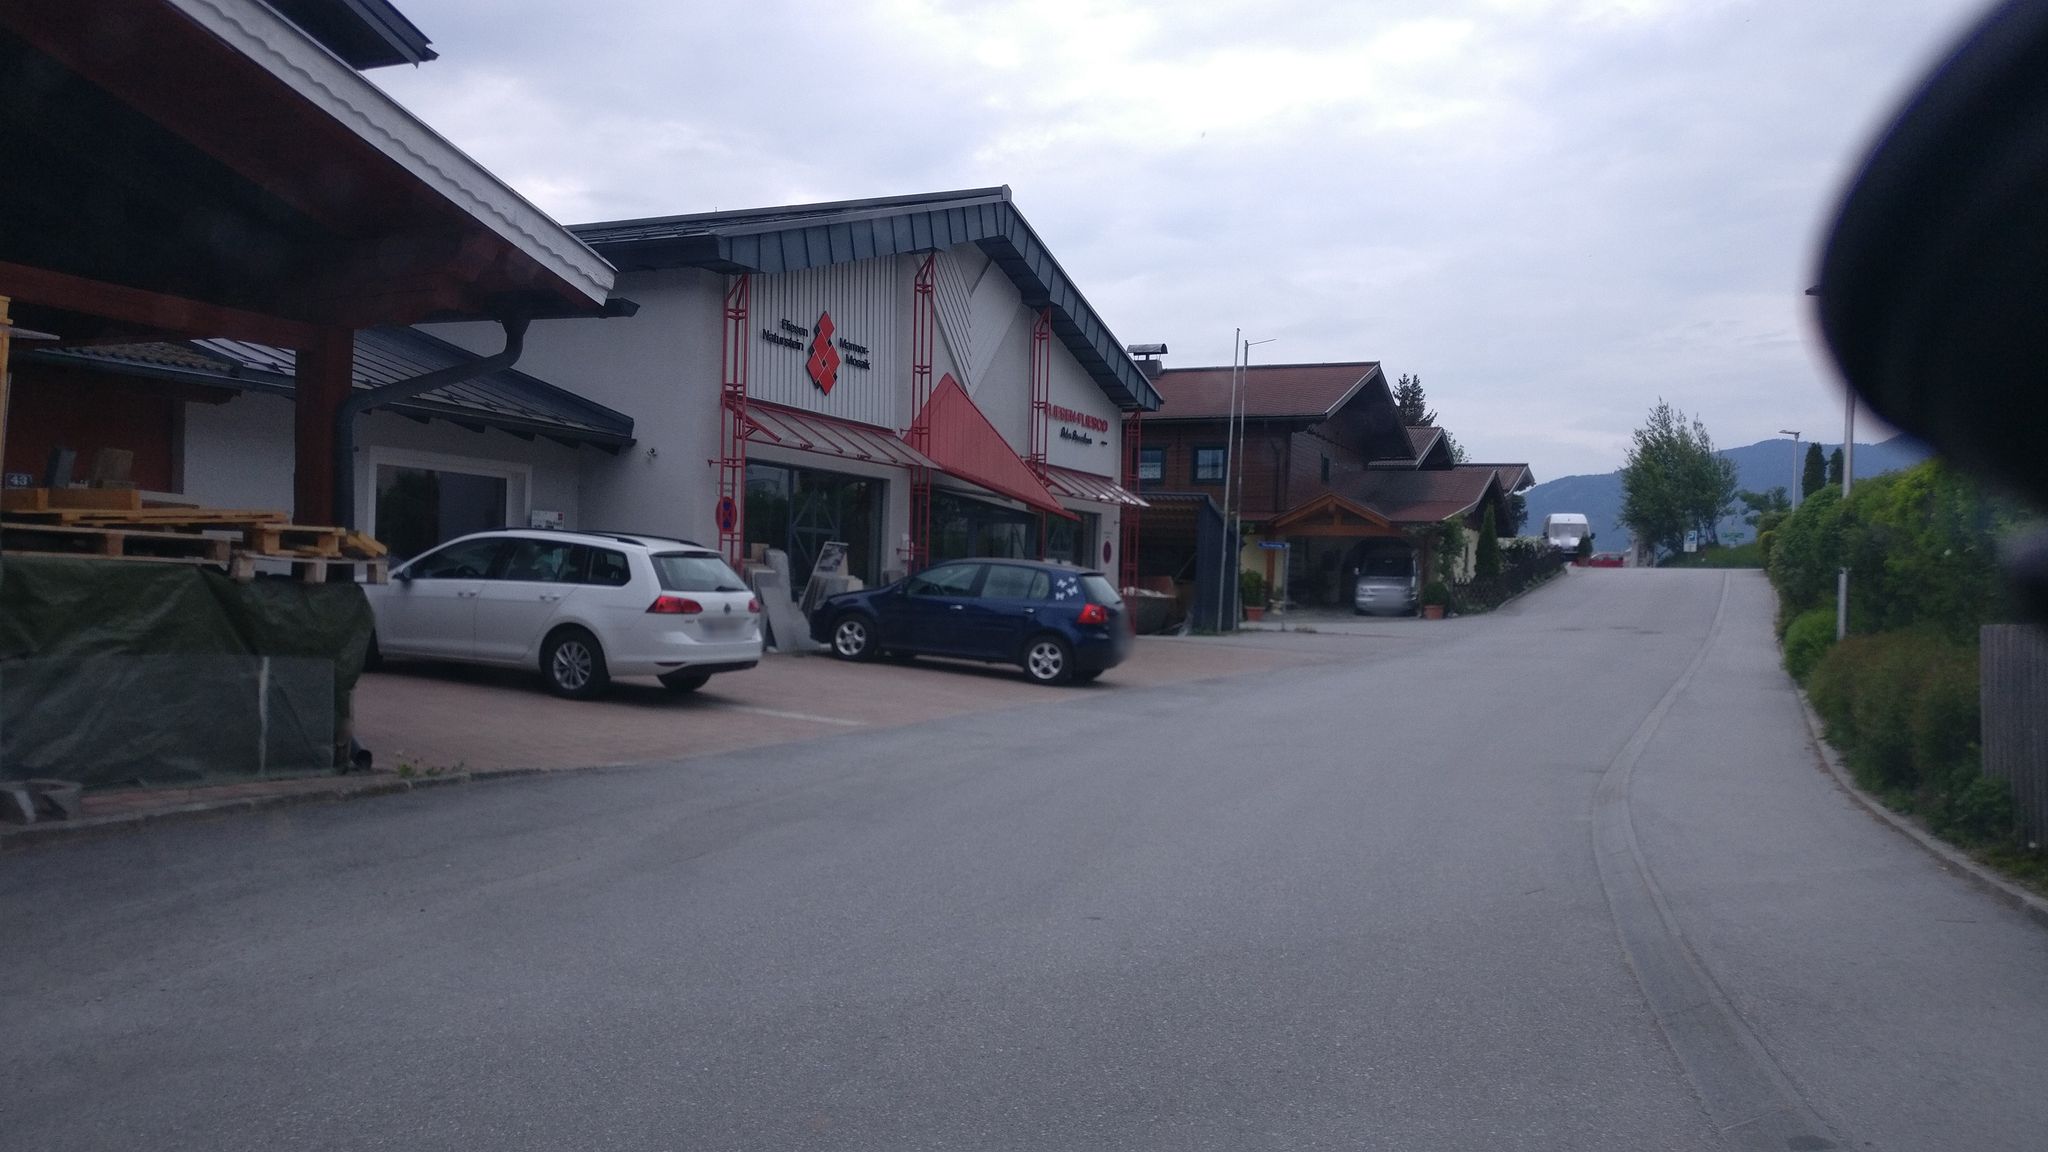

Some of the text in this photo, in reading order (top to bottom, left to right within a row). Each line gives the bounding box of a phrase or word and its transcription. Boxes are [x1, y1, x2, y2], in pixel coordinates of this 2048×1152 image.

[781, 319, 809, 338] Fliesen
[762, 329, 804, 351] Naturstein
[845, 354, 871, 370] Mosaik
[10, 475, 28, 486] 43
